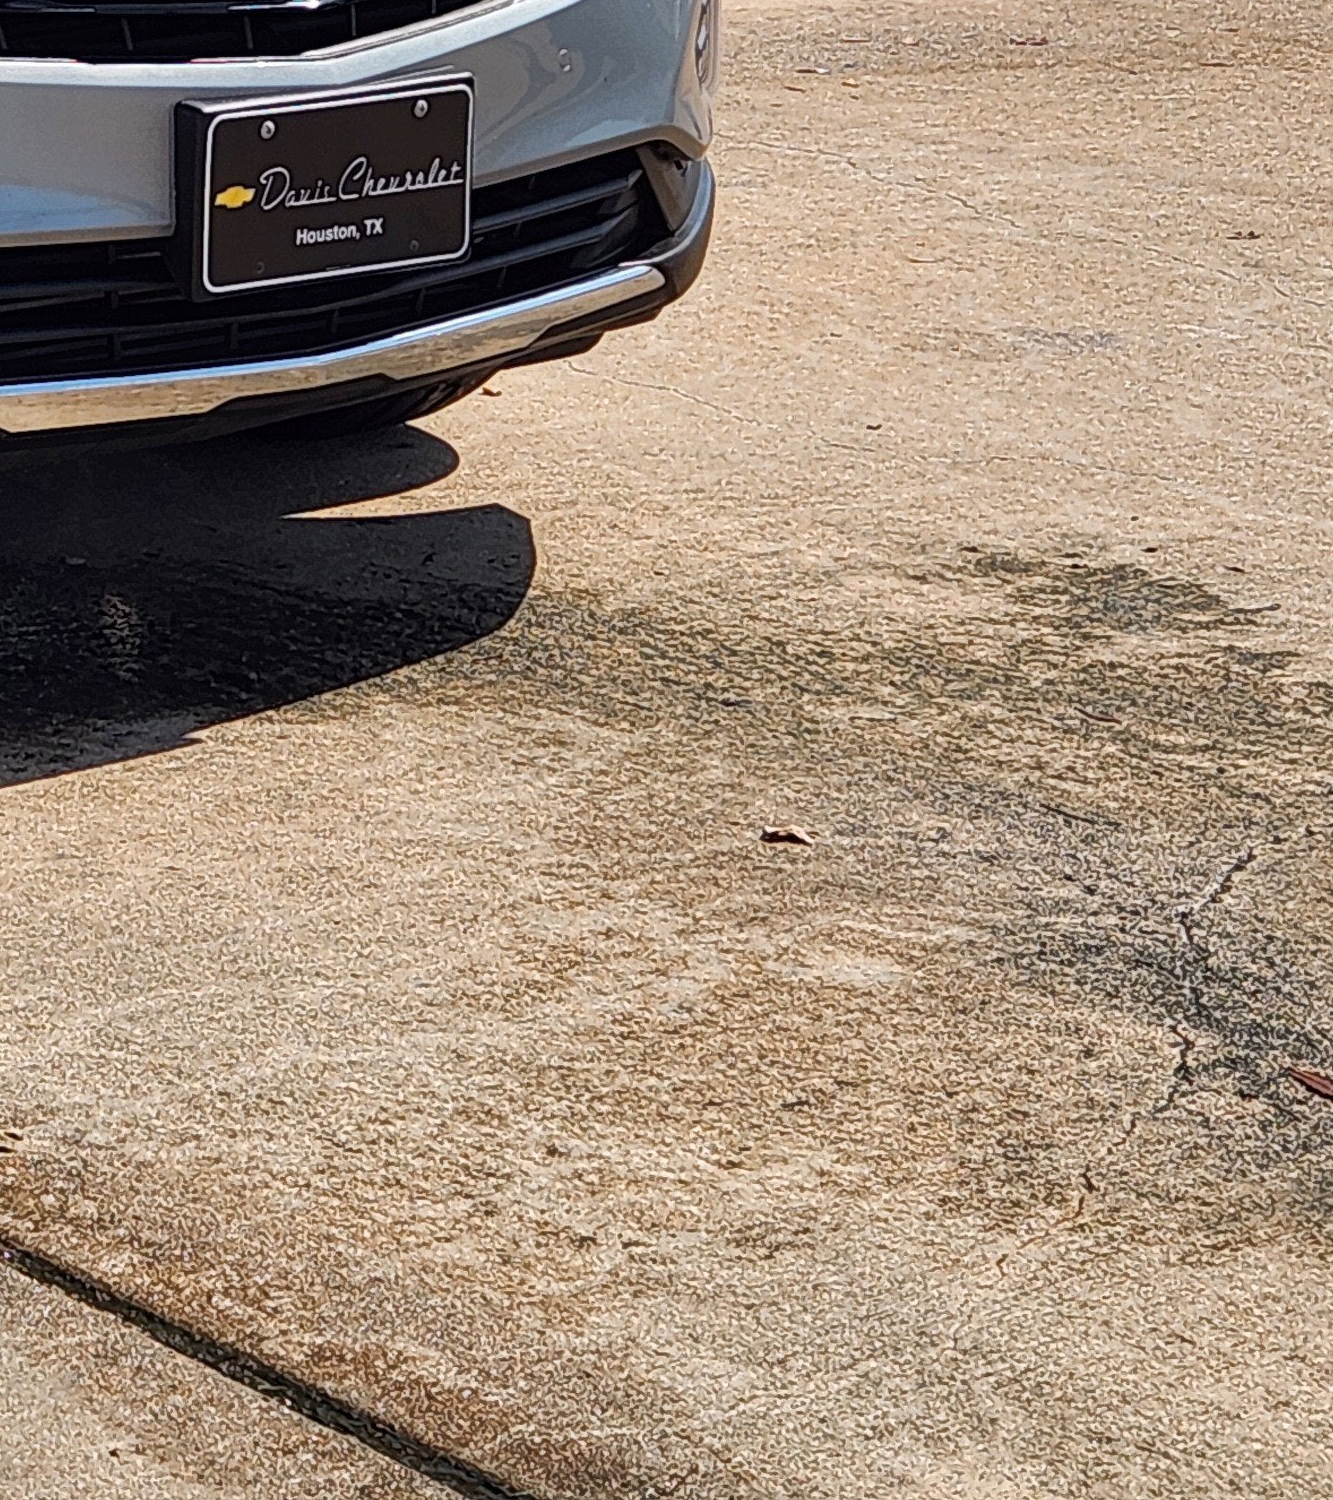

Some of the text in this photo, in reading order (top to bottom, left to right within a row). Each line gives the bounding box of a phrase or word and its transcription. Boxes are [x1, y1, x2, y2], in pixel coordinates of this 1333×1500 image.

[259, 156, 465, 212] Davis Chevrolet
[295, 217, 384, 246] Houston, TX
